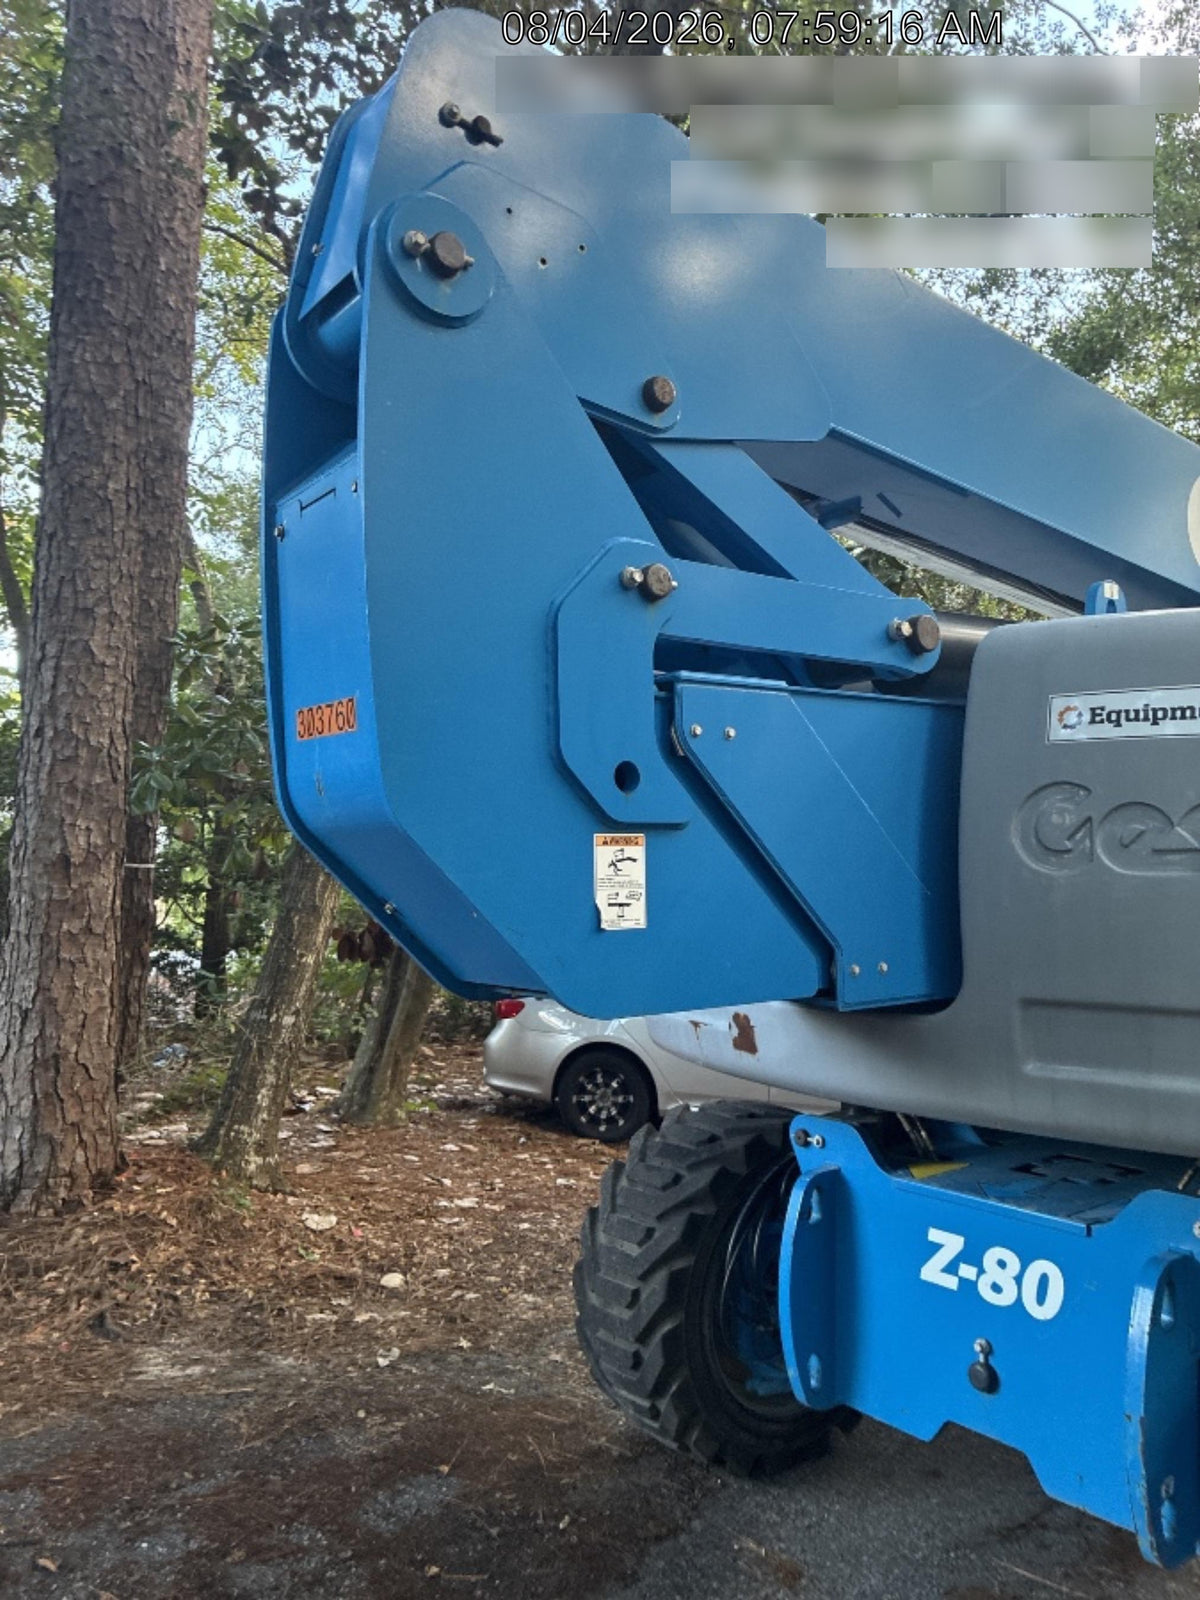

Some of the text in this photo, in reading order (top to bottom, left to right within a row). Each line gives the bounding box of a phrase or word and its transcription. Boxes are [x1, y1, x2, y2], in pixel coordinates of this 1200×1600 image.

[297, 697, 356, 739] 303760
[1088, 703, 1200, 728] Equipm
[919, 1226, 1065, 1321] Z-80
